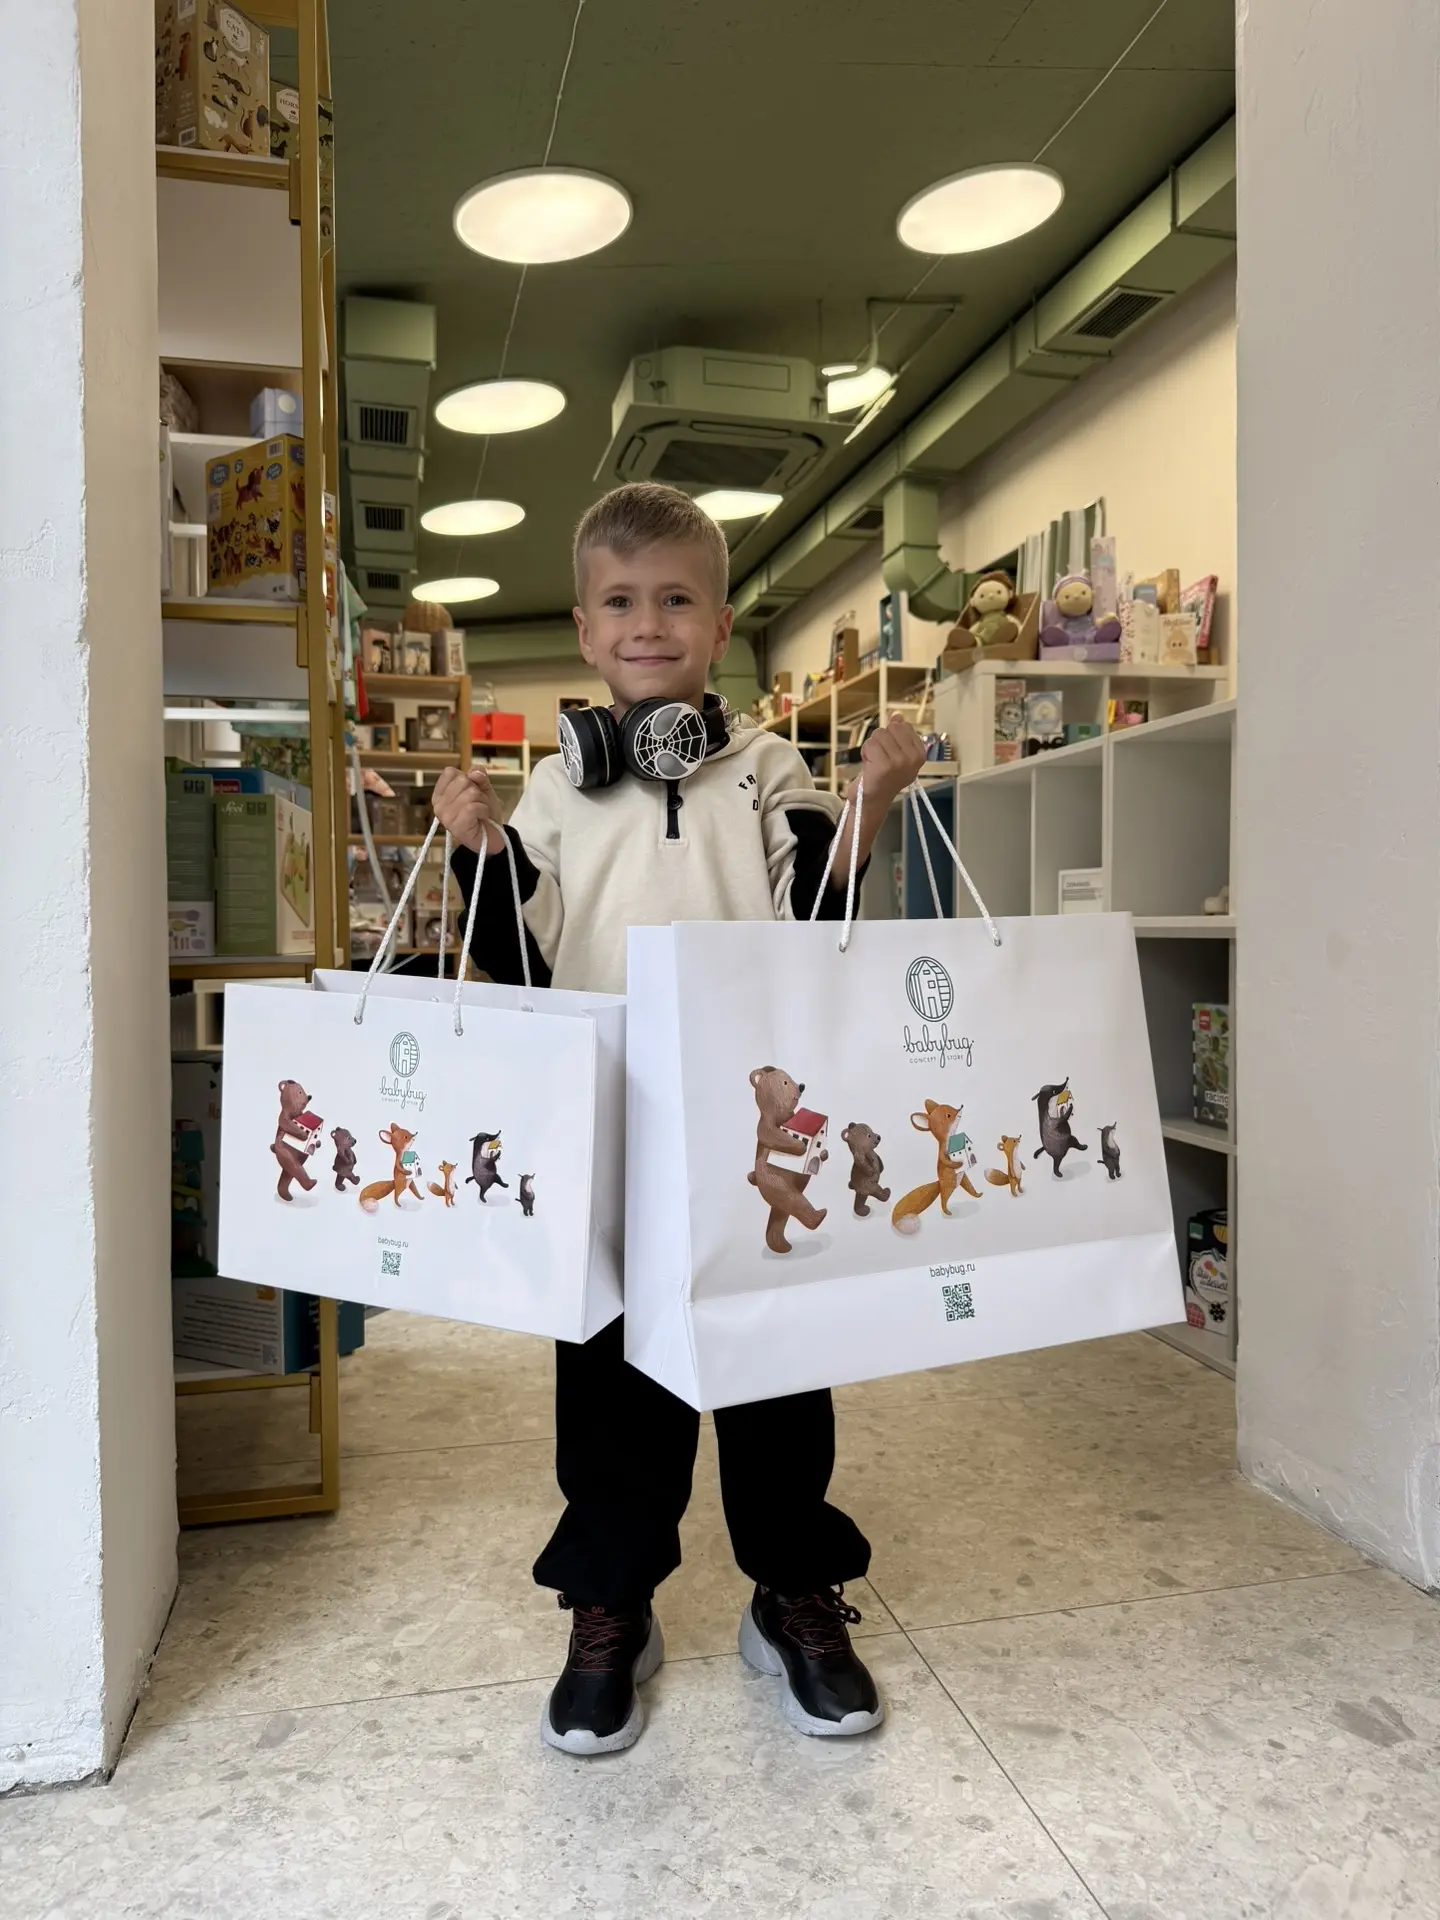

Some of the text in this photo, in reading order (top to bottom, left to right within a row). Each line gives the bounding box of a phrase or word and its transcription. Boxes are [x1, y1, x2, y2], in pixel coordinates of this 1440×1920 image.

[903, 1022, 975, 1068] babybug
[379, 1075, 428, 1112] babybug
[929, 1263, 976, 1278] babybug.ru
